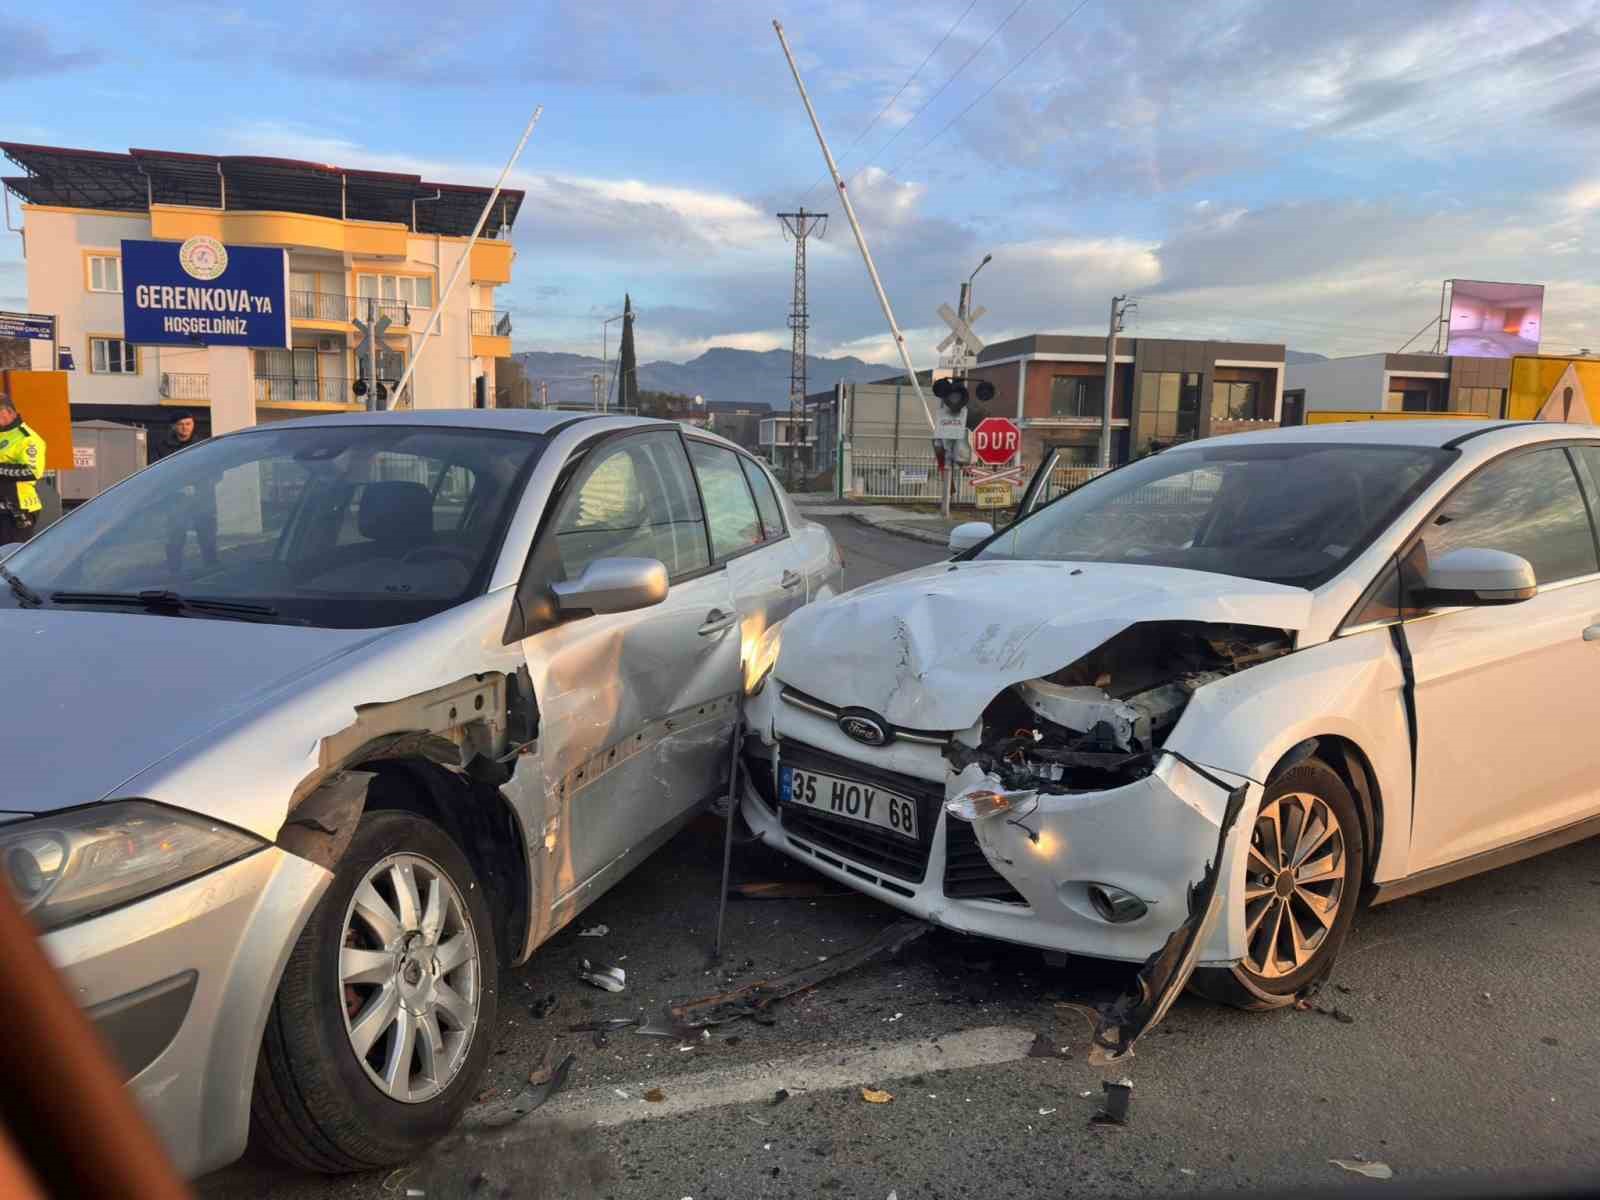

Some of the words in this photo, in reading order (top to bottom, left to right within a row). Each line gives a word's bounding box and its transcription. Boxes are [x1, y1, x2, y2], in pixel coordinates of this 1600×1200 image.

[136, 285, 272, 313] GERENKOVA'YA
[164, 316, 247, 335] HOŞGELDİNİZ
[977, 431, 1017, 450] DUR
[792, 772, 817, 803] 35
[830, 781, 876, 819] HOY
[888, 798, 913, 833] 68
